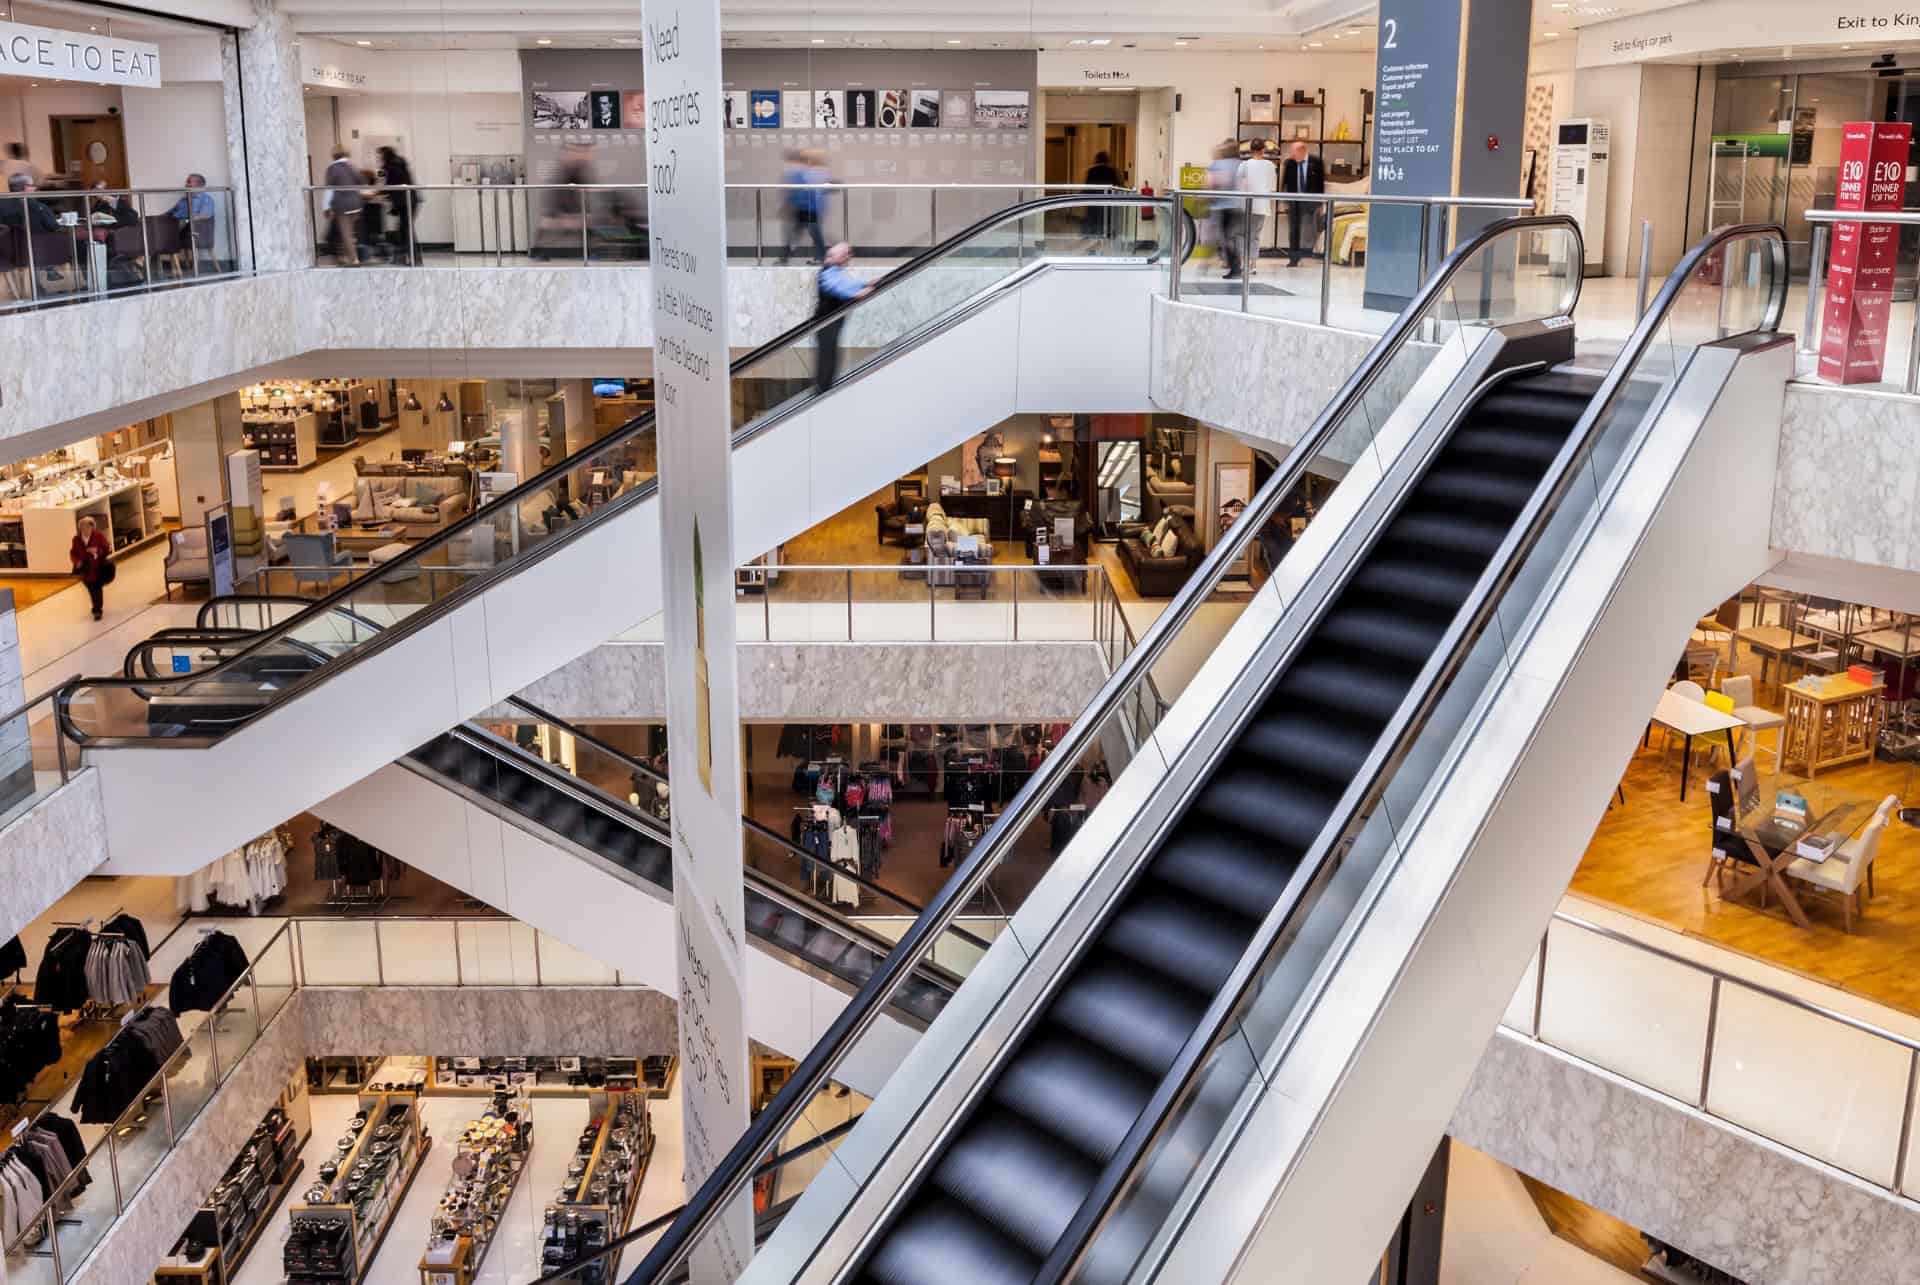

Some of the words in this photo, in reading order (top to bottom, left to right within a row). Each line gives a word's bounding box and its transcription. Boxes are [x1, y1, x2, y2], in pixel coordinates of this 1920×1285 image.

[1837, 16, 1866, 29] Exit
[1872, 16, 1888, 27] to
[1893, 13, 1920, 28] Kin
[650, 8, 679, 64] Need
[1384, 18, 1397, 49] 2
[65, 43, 102, 71] TO
[112, 49, 156, 77] EAT
[1083, 70, 1111, 81] Toilets
[651, 80, 701, 144] groceries
[1393, 145, 1415, 153] PLACE
[1416, 145, 1426, 153] TO
[1426, 144, 1440, 153] EAT
[653, 149, 677, 194] too?
[1874, 161, 1902, 182] £10
[1840, 182, 1862, 192] DINNER
[1872, 183, 1900, 193] DINNER
[1884, 193, 1898, 201] TWO
[680, 912, 711, 1004] Need
